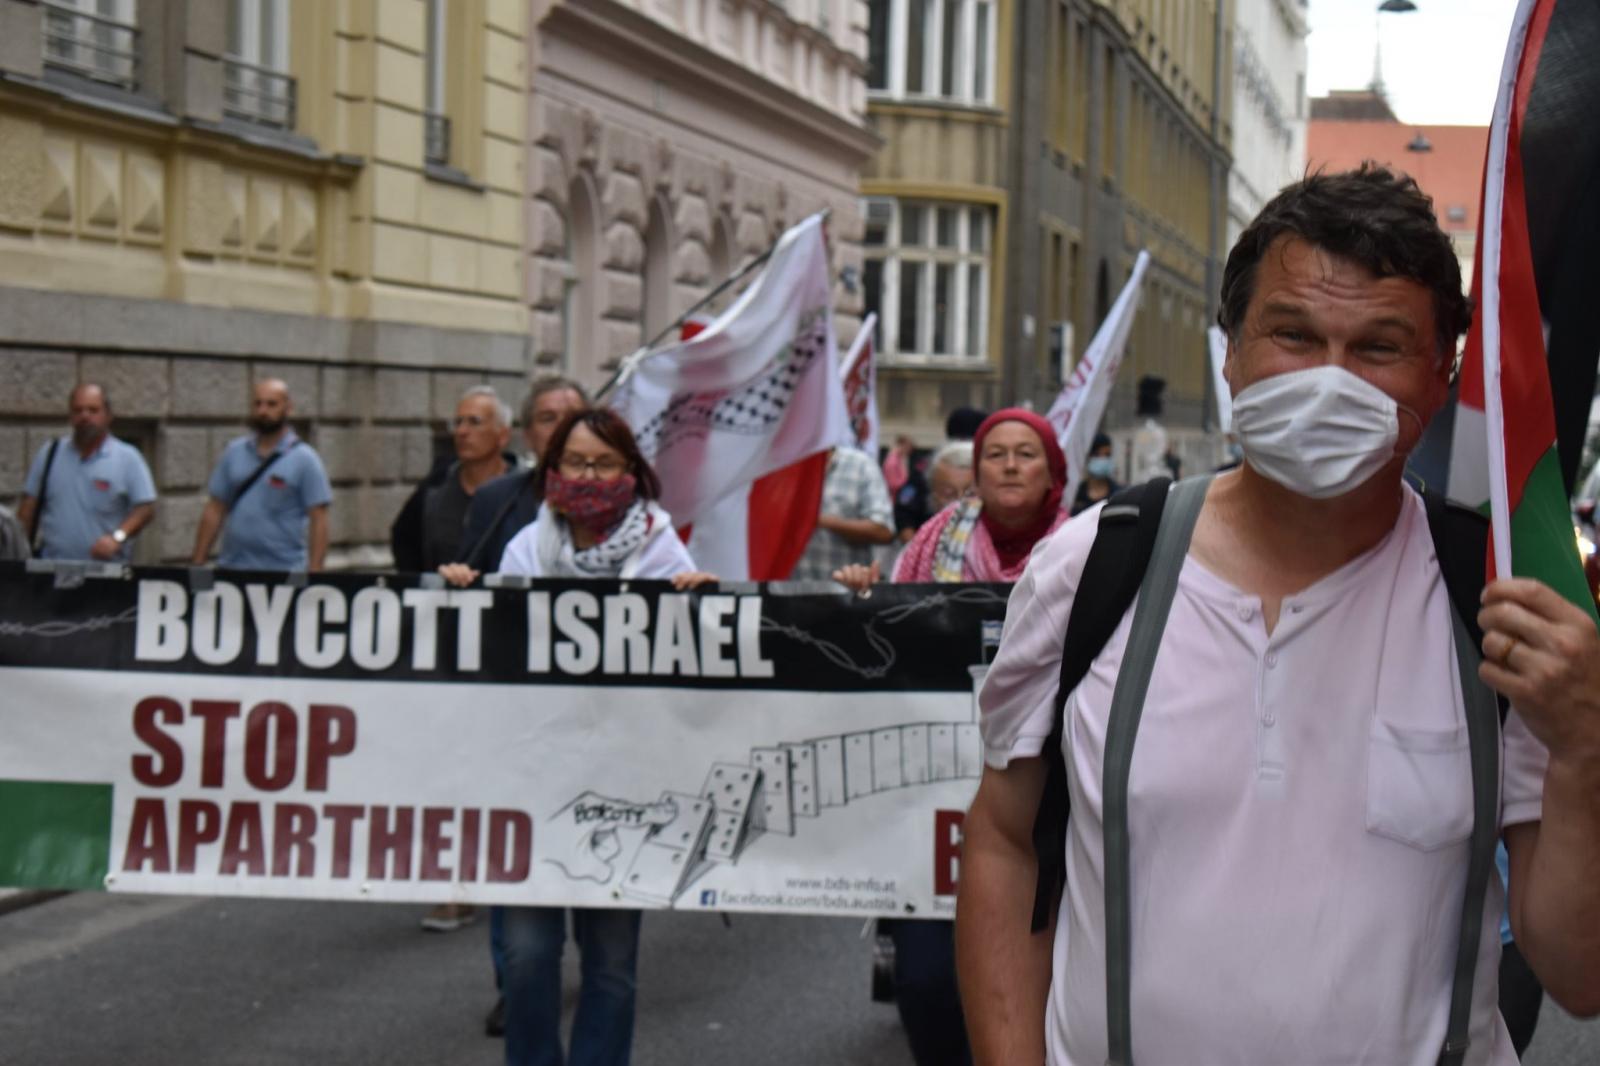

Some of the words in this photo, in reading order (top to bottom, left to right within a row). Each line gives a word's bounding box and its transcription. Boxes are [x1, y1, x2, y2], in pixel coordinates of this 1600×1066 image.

[135, 579, 494, 671] BOYCOTT
[527, 590, 775, 677] ISRAEL
[131, 696, 358, 793] STOP
[121, 797, 533, 884] APARTHEID
[785, 876, 896, 893] www.bds-info.at
